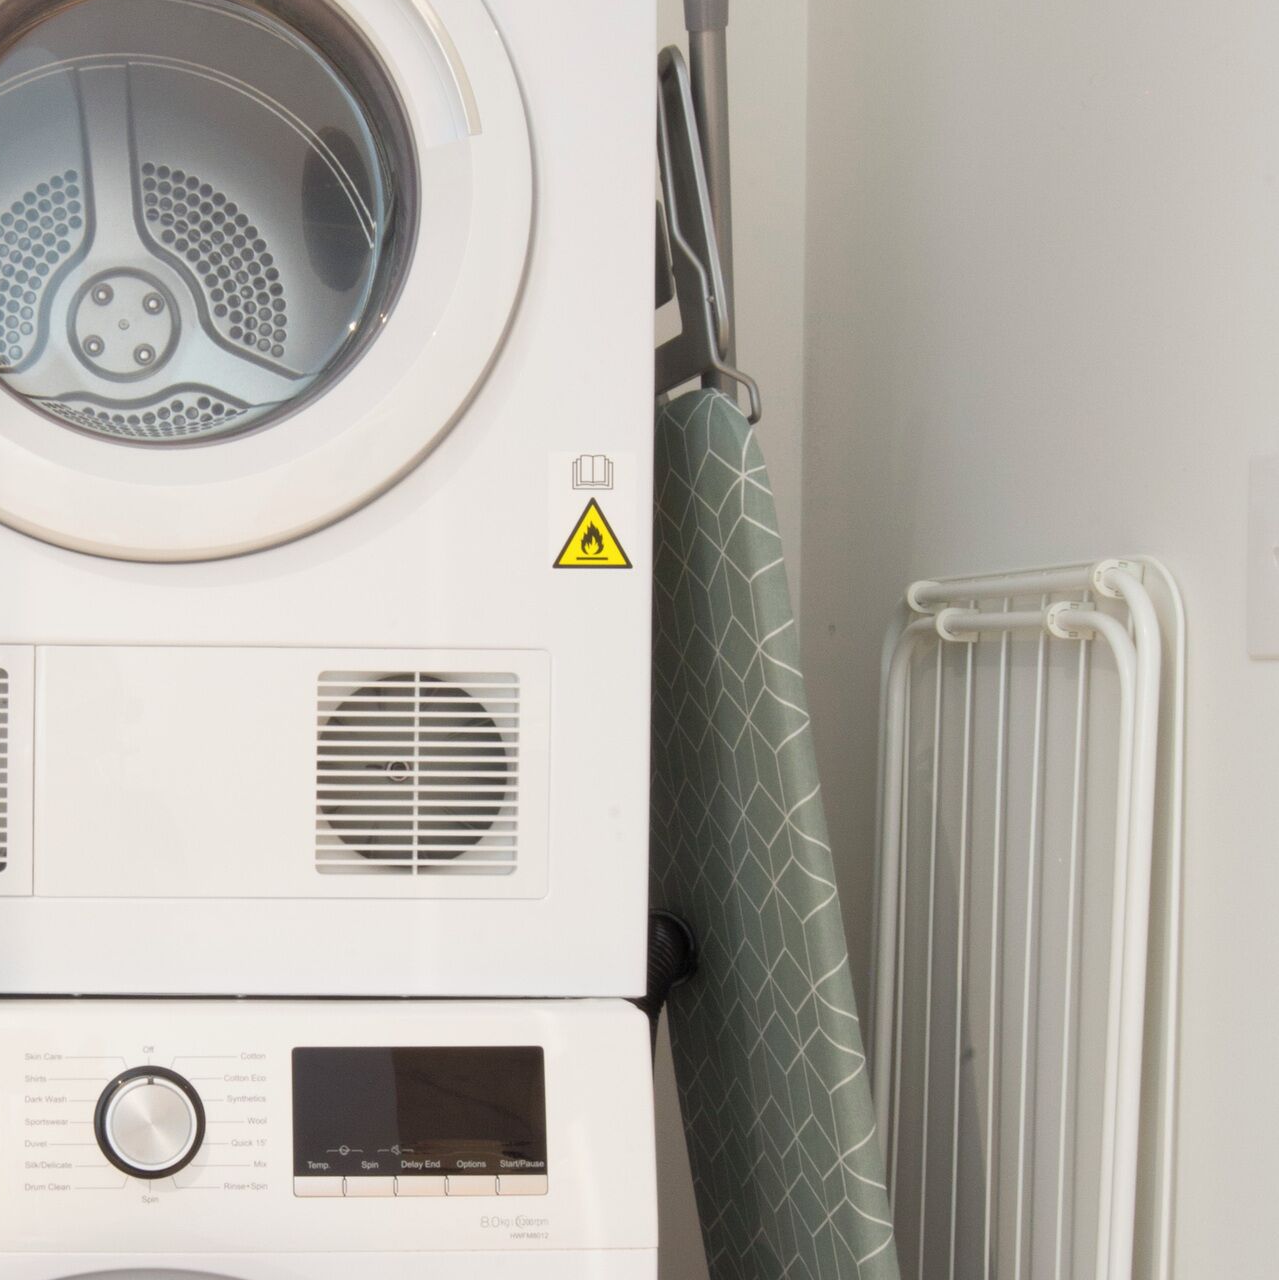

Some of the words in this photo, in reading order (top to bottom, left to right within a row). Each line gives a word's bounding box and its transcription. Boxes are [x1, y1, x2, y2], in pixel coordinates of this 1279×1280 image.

[307, 1161, 331, 1171] Temp.
[361, 1160, 380, 1171] Spin
[401, 1160, 424, 1170] Delay
[426, 1160, 441, 1170] End
[456, 1160, 487, 1170] Options
[500, 1159, 545, 1169] Start/Pause
